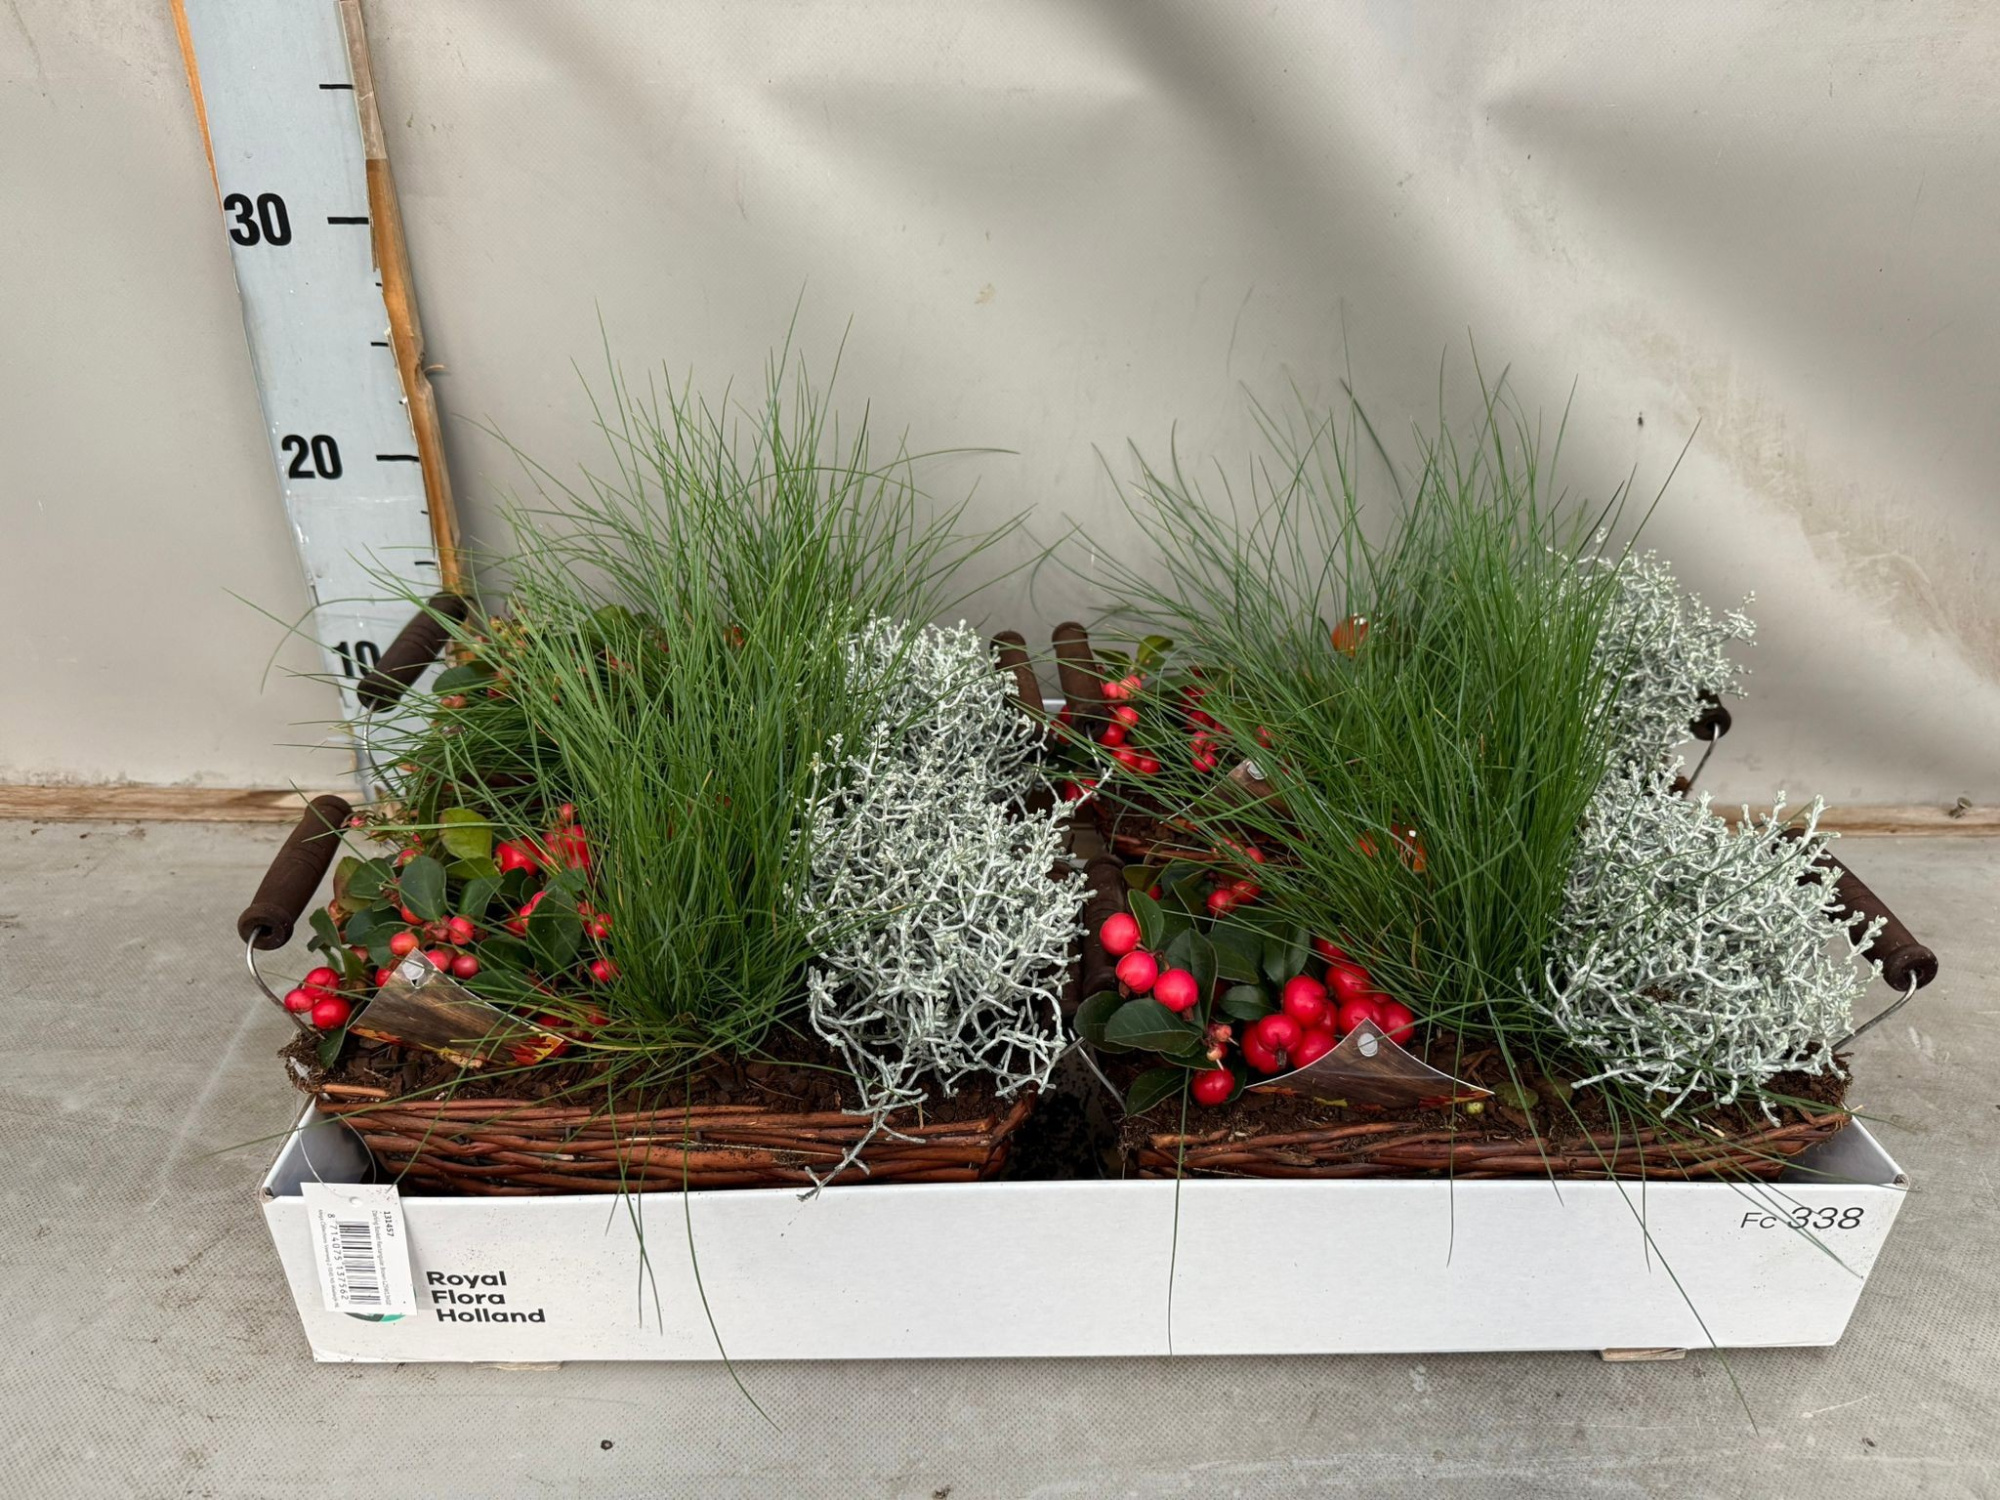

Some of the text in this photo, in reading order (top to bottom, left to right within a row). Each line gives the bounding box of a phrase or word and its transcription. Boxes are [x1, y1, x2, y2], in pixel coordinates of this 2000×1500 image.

[224, 193, 291, 246] 30
[280, 433, 343, 480] 20
[330, 640, 381, 679] 10
[383, 1211, 395, 1237] 131457
[1740, 1206, 1865, 1230] Fc 338
[329, 1224, 342, 1261] 714075
[335, 1265, 349, 1300] 137562
[426, 1271, 507, 1289] Royal
[431, 1289, 506, 1305] Flora
[436, 1308, 546, 1323] Holland
